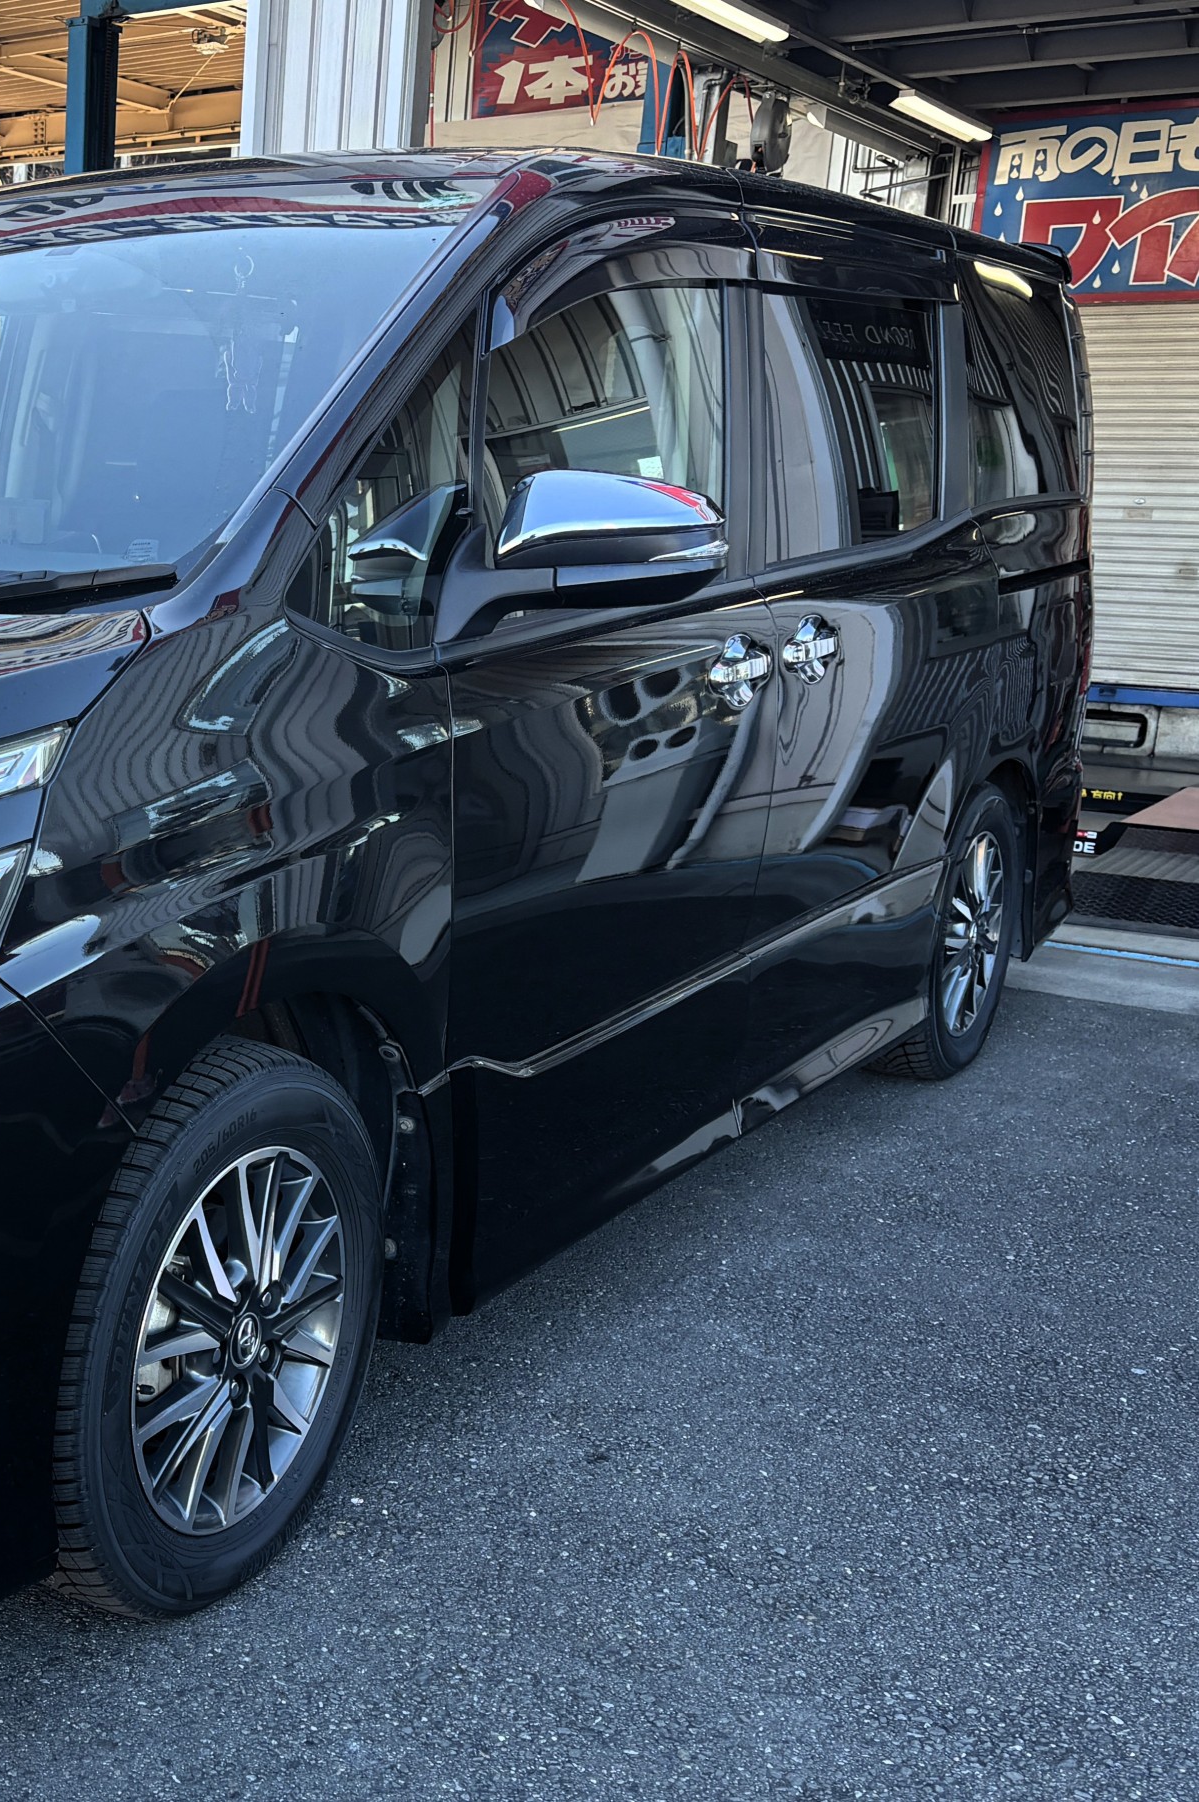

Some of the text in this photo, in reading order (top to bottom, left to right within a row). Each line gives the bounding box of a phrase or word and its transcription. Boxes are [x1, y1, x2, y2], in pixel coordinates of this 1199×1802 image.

[494, 54, 594, 104] 1本
[1019, 187, 1199, 289] ワイ
[193, 1107, 258, 1176] 205/60R16
[112, 1198, 175, 1376] DUNLOP
